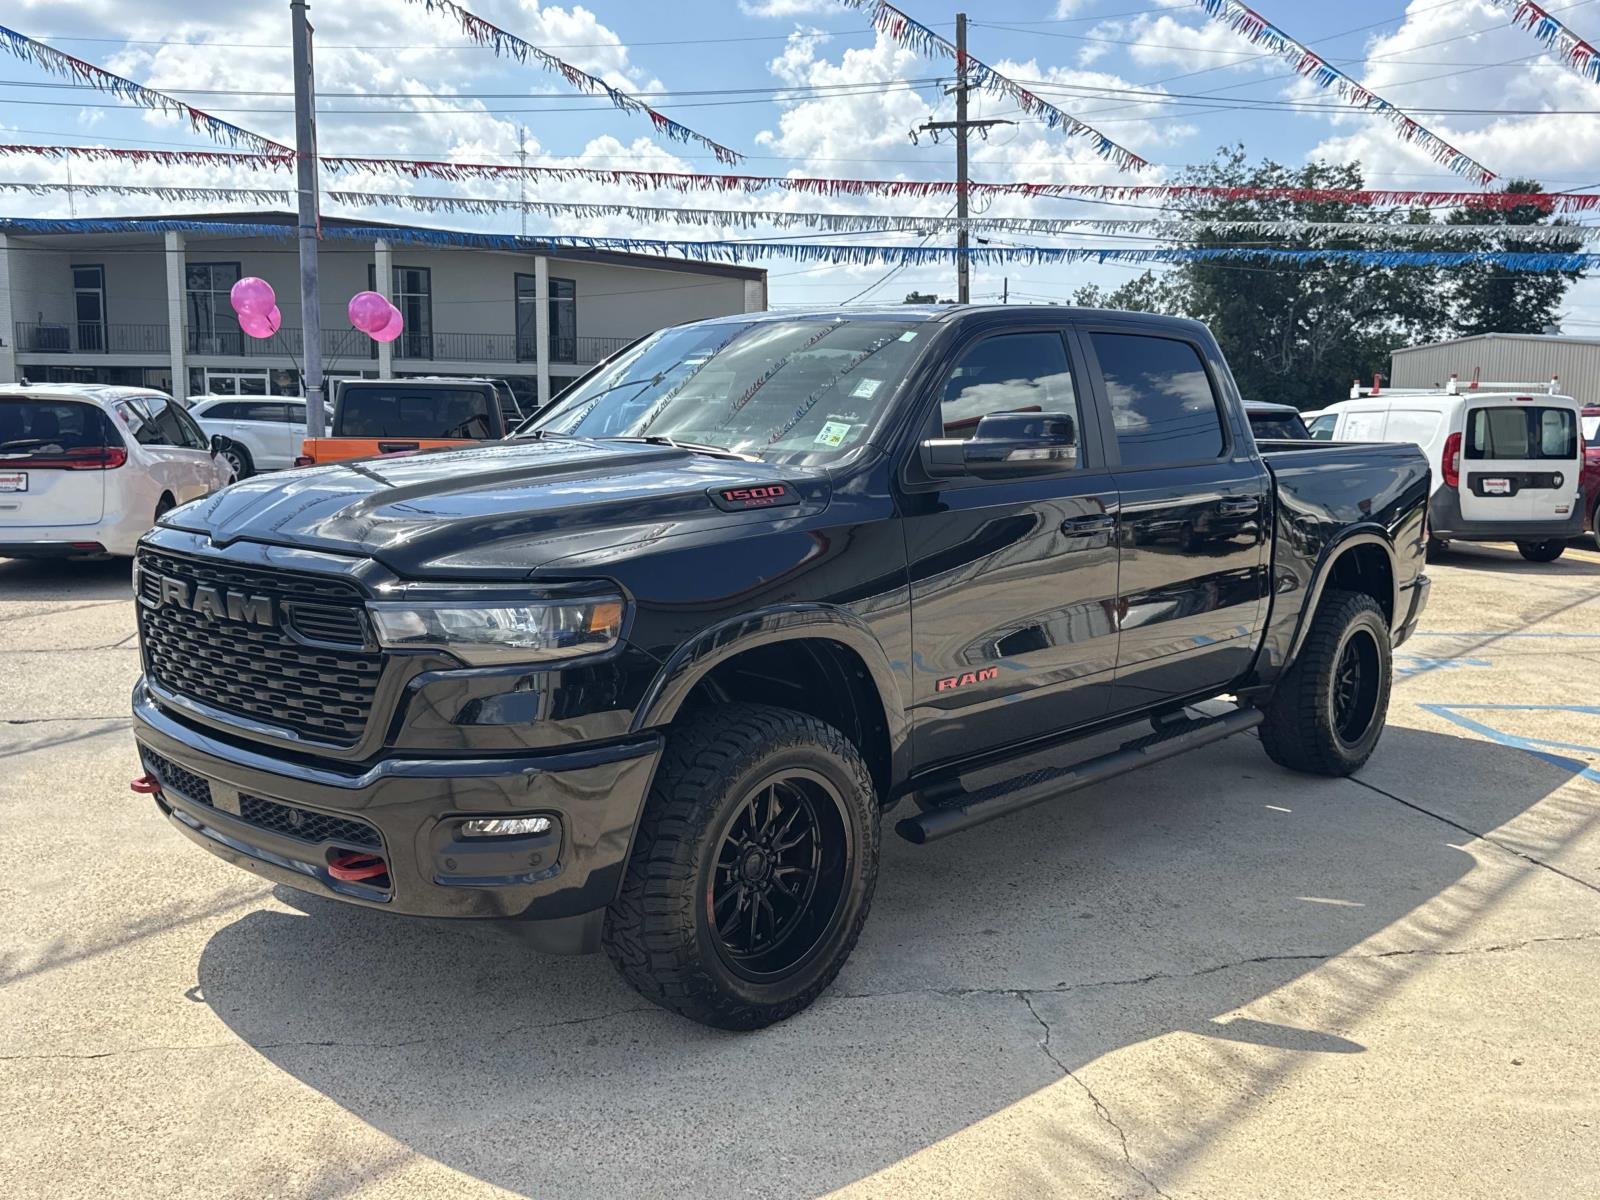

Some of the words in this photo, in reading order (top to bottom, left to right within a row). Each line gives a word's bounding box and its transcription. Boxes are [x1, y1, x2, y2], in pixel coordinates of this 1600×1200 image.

[722, 485, 785, 501] 1500
[161, 575, 273, 626] RAM
[936, 666, 998, 692] RAM
